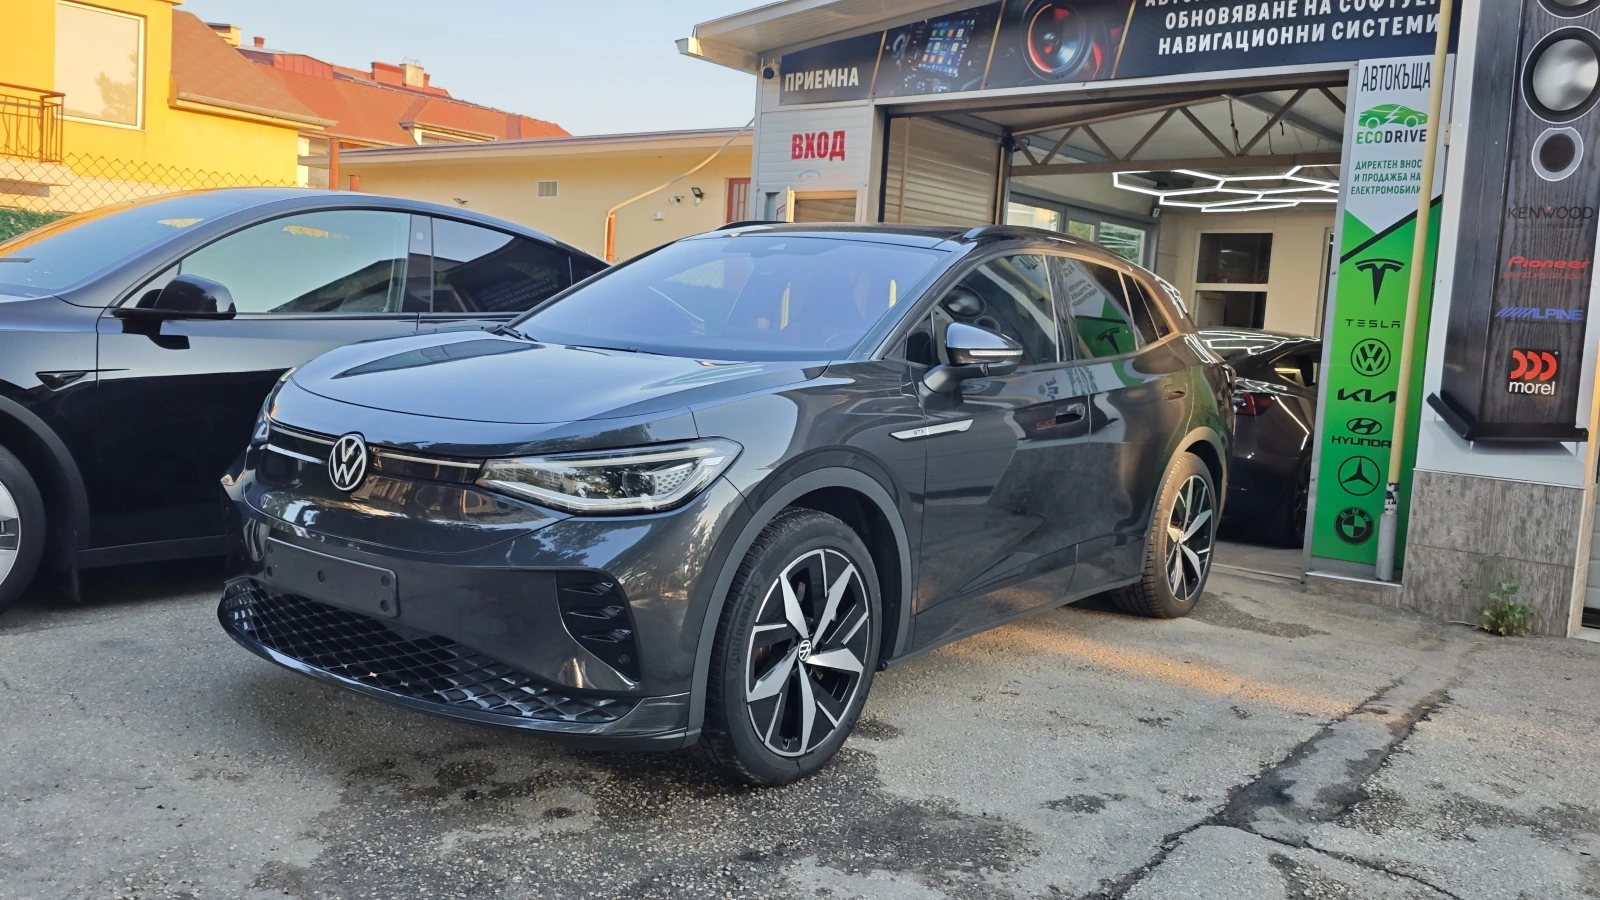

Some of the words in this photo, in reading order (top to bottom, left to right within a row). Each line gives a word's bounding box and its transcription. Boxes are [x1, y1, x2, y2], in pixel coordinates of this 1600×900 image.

[1165, 0, 1298, 30] ОБНОВЯВАНЕ
[1304, 0, 1332, 16] НА
[1158, 23, 1326, 55] НАВИГАЦИОННИ
[1331, 13, 1440, 40] СИСТЕМИ
[784, 67, 859, 92] ПРИЕМНА
[1361, 62, 1431, 92] АВТОКЪЩА
[1356, 129, 1427, 144] ECODRIVE
[791, 130, 846, 162] ВХОД
[1355, 160, 1398, 171] ДИРЕКТЕН
[1400, 159, 1423, 169] ВНОС
[1354, 173, 1360, 182] И
[1362, 172, 1408, 183] ПРОДАЖБА
[1410, 172, 1421, 181] НА
[1507, 206, 1594, 219] KENWOOD
[1507, 255, 1591, 269] Pioneer
[1520, 306, 1584, 321] ALPINE
[1345, 318, 1401, 329] TESLA
[1508, 381, 1556, 396] morel
[1331, 435, 1393, 449] HYUNDA
